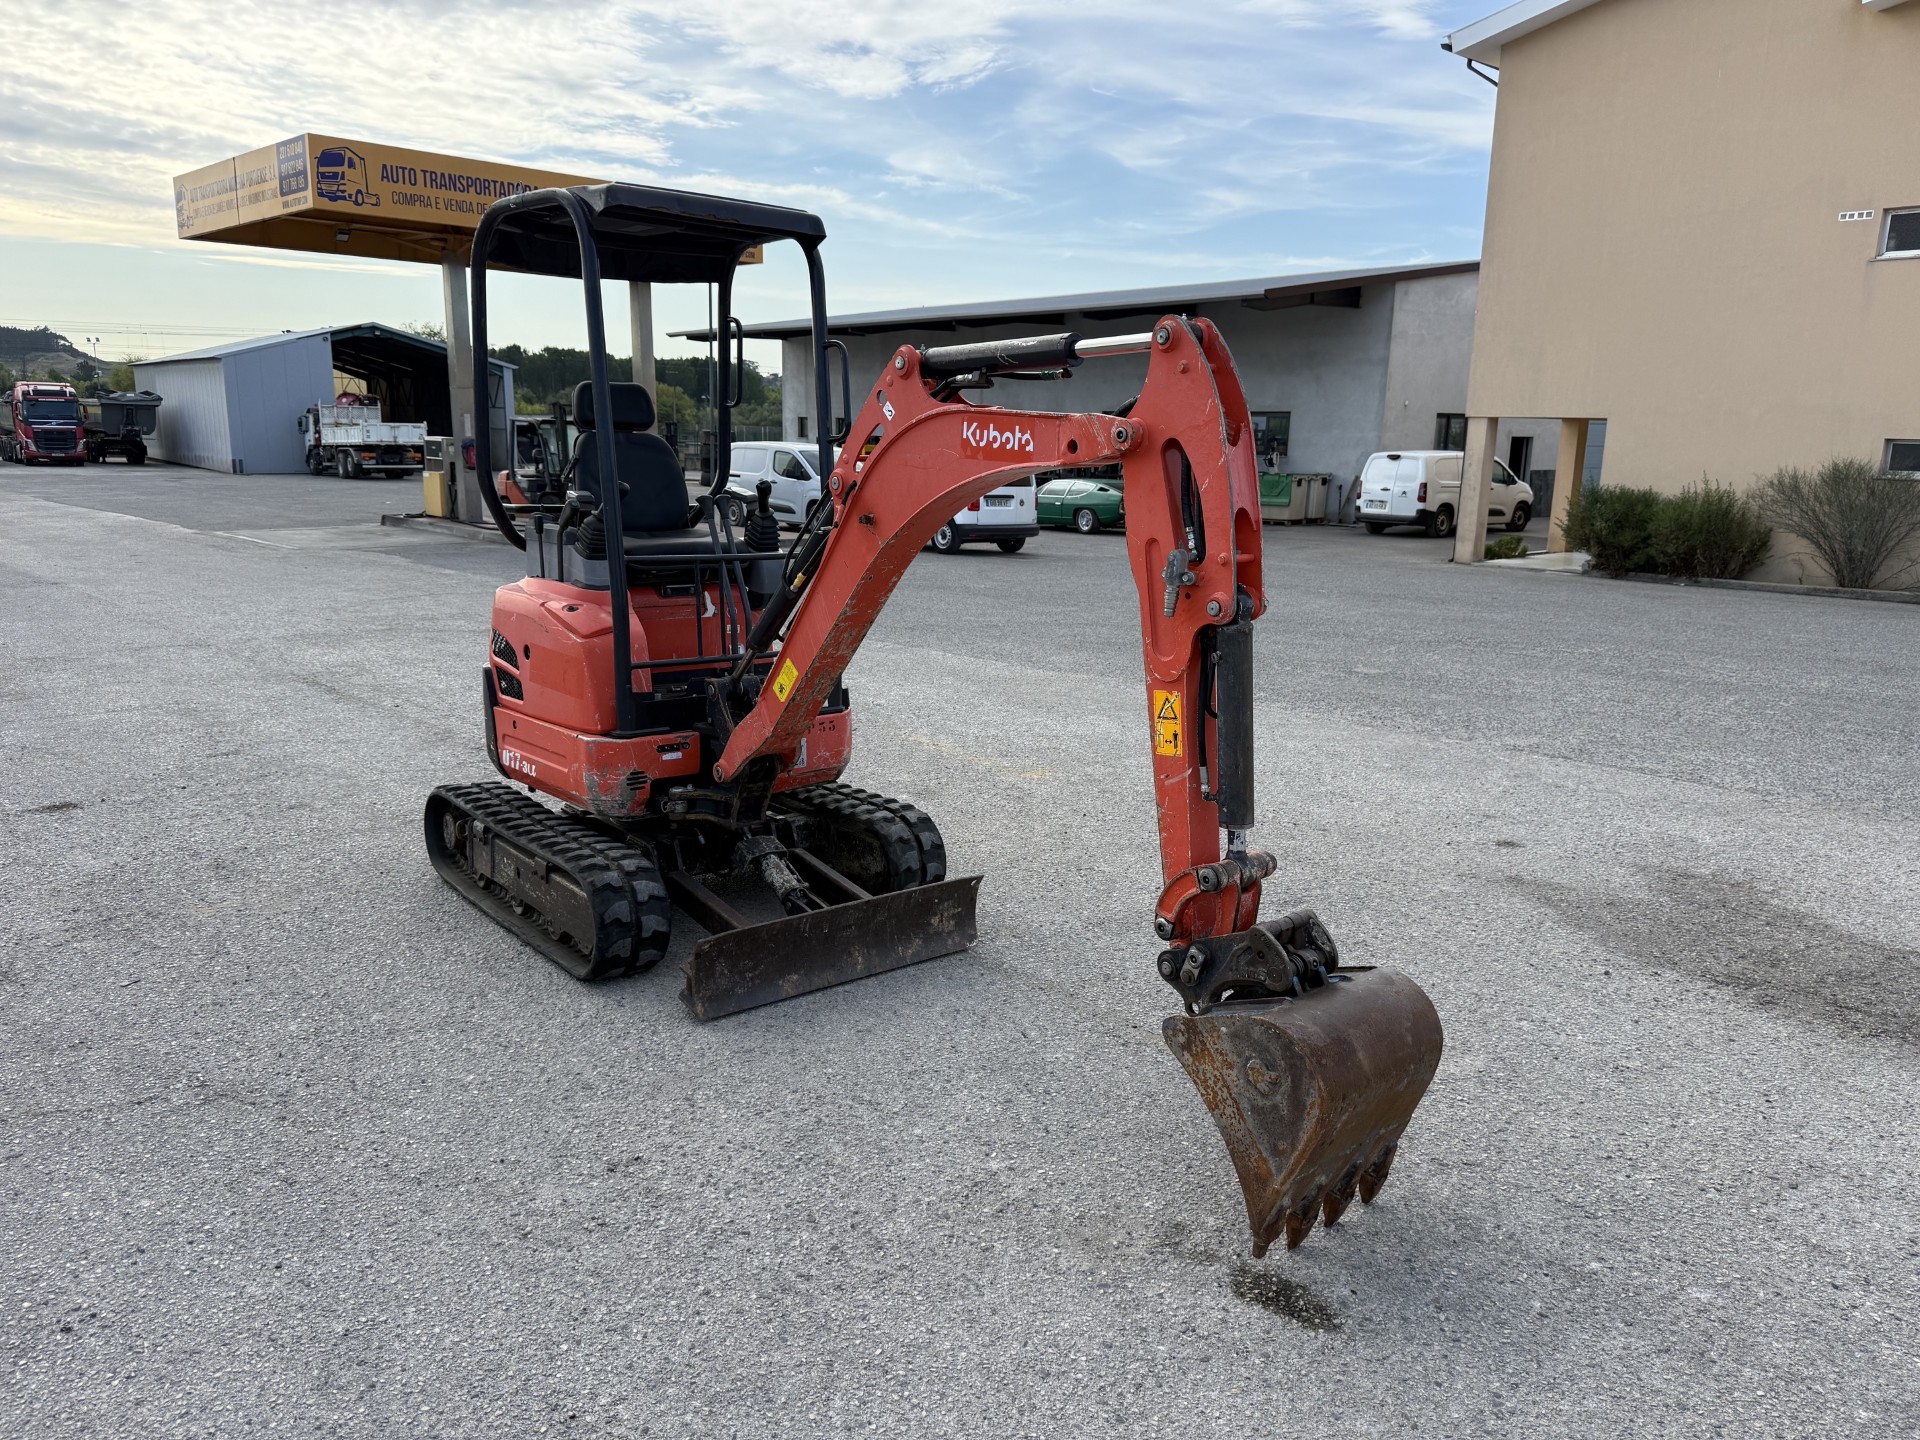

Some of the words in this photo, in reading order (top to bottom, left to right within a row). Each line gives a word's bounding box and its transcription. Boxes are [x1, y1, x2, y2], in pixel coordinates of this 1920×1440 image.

[381, 163, 418, 187] AUTO
[420, 169, 539, 198] TRANSPORTADO
[391, 190, 433, 209] COMPRA
[435, 196, 441, 210] E
[443, 197, 475, 214] VENDA
[962, 421, 1034, 452] Kubota
